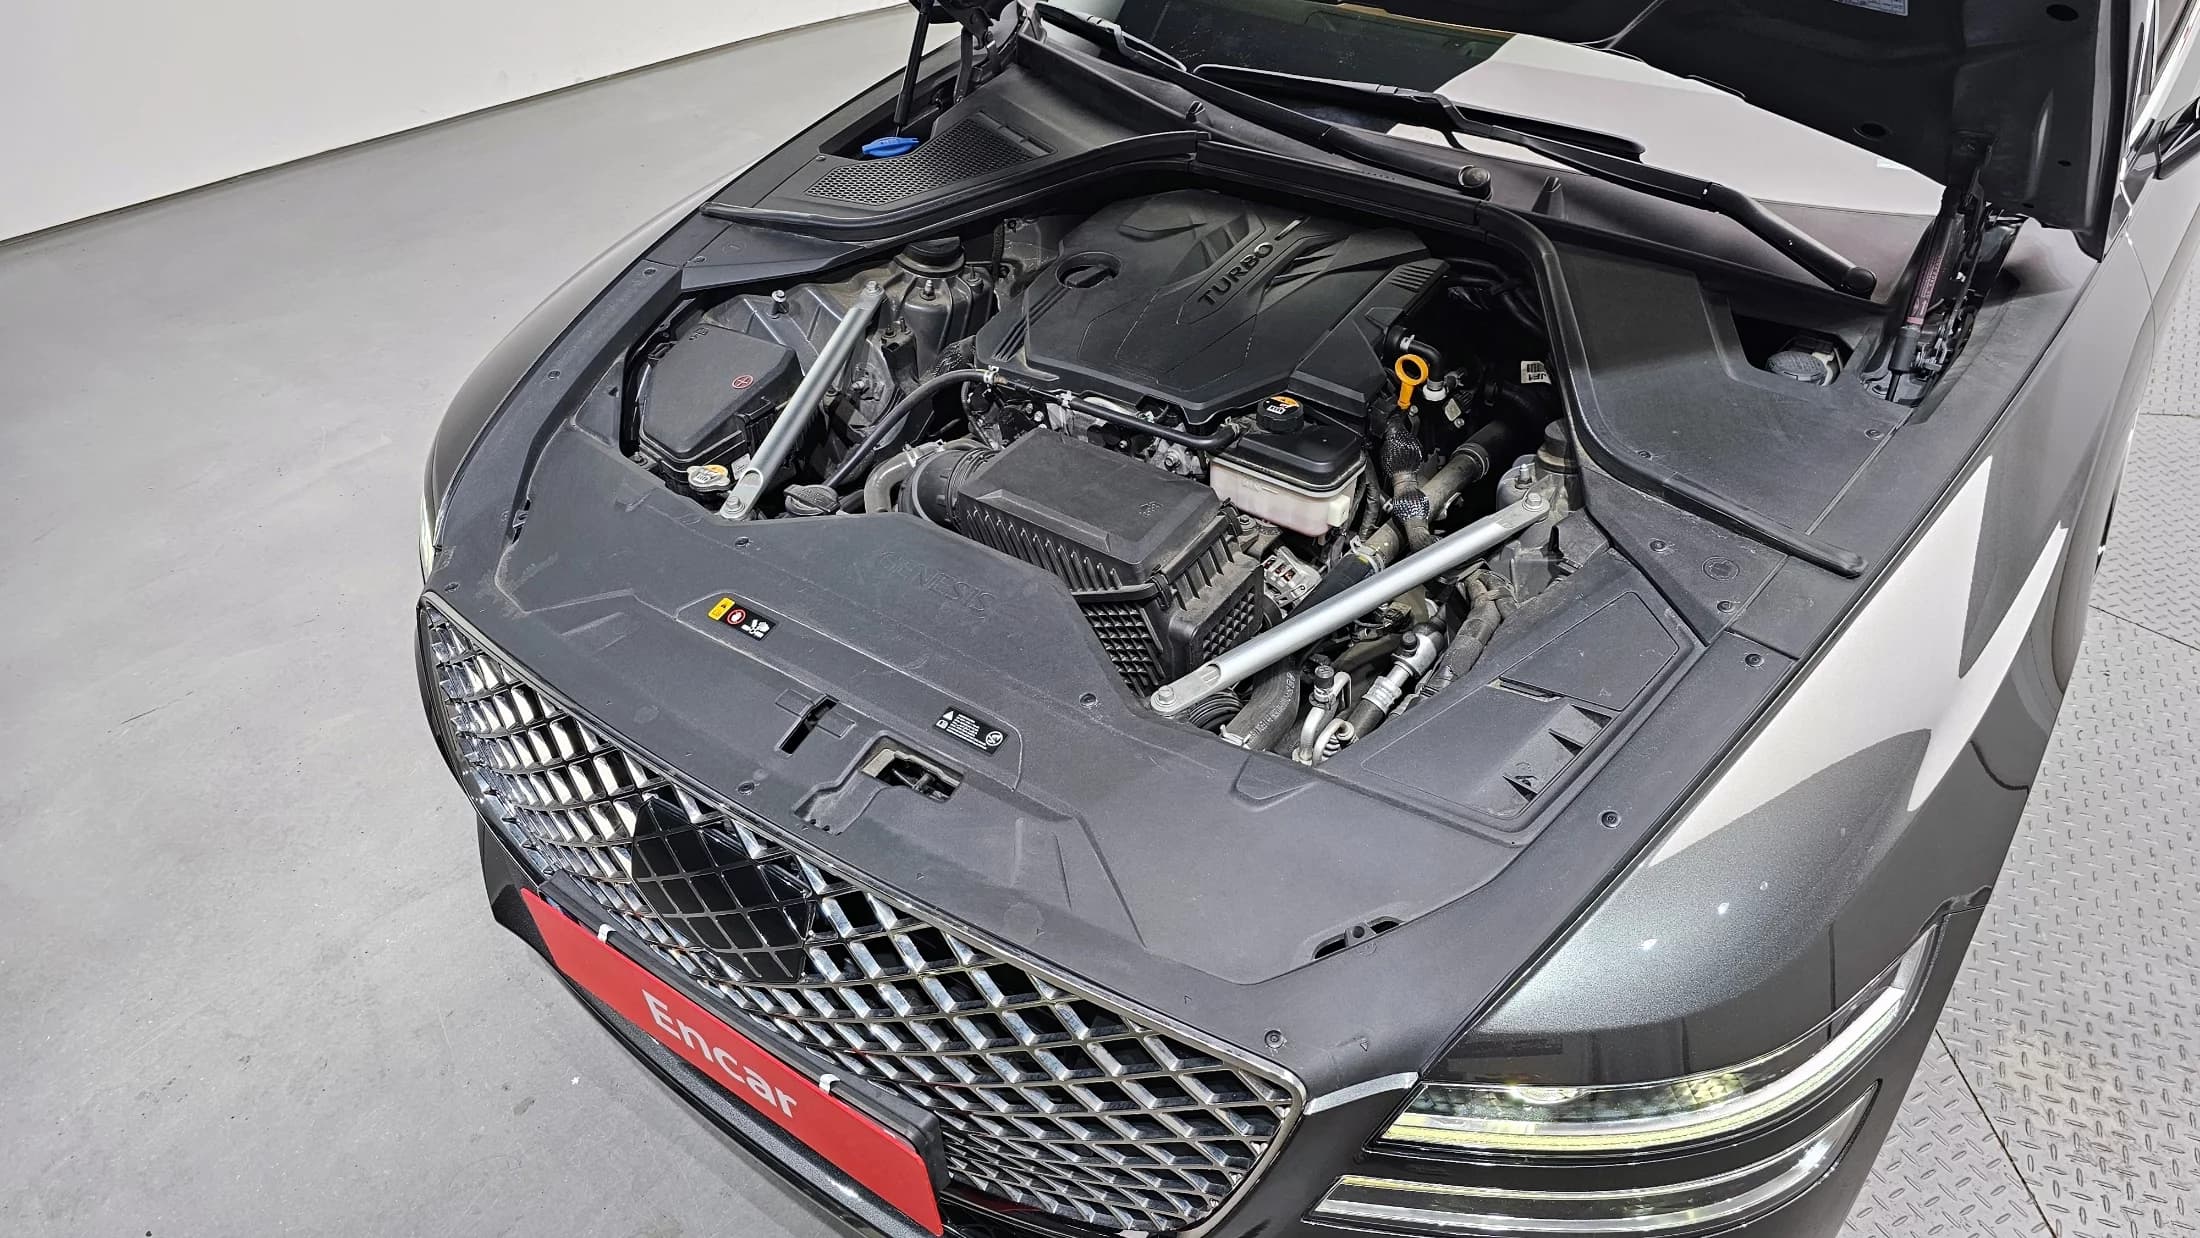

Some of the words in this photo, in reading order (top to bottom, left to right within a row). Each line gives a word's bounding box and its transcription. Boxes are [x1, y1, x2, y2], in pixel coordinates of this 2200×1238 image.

[1198, 242, 1273, 305] TURBO
[880, 551, 996, 612] GENESIS
[641, 989, 797, 1118] Encar
